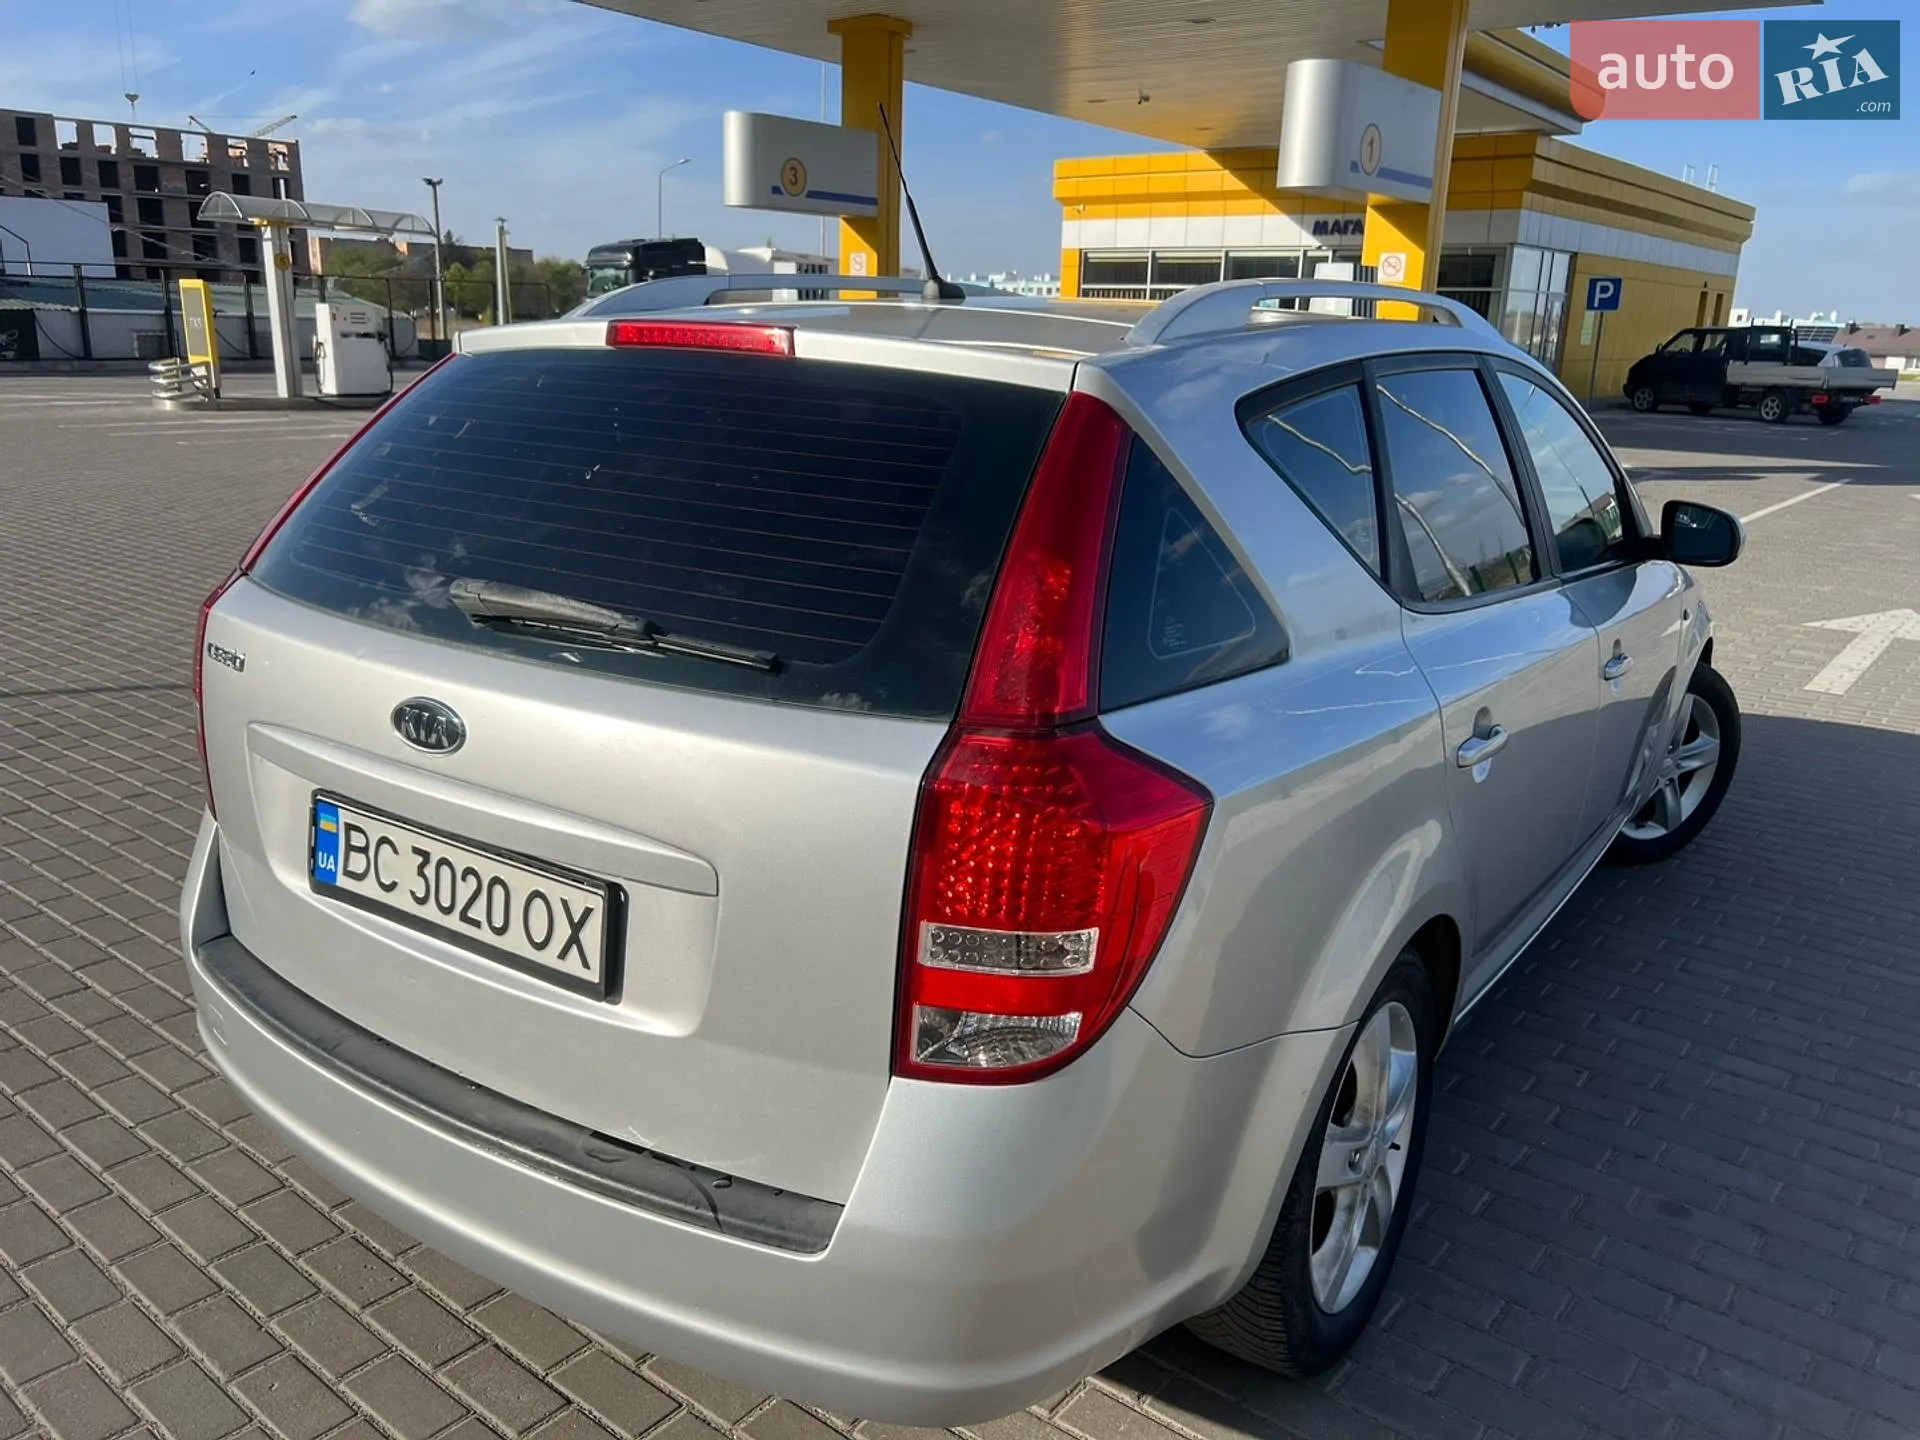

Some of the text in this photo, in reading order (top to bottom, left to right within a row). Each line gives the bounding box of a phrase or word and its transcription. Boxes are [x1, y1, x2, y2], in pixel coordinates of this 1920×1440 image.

[1367, 136, 1375, 164] 1
[789, 166, 798, 186] 3
[1593, 280, 1615, 308] P
[400, 705, 450, 746] KIA
[318, 850, 336, 873] UA
[342, 823, 595, 971] BC 3020 OX
